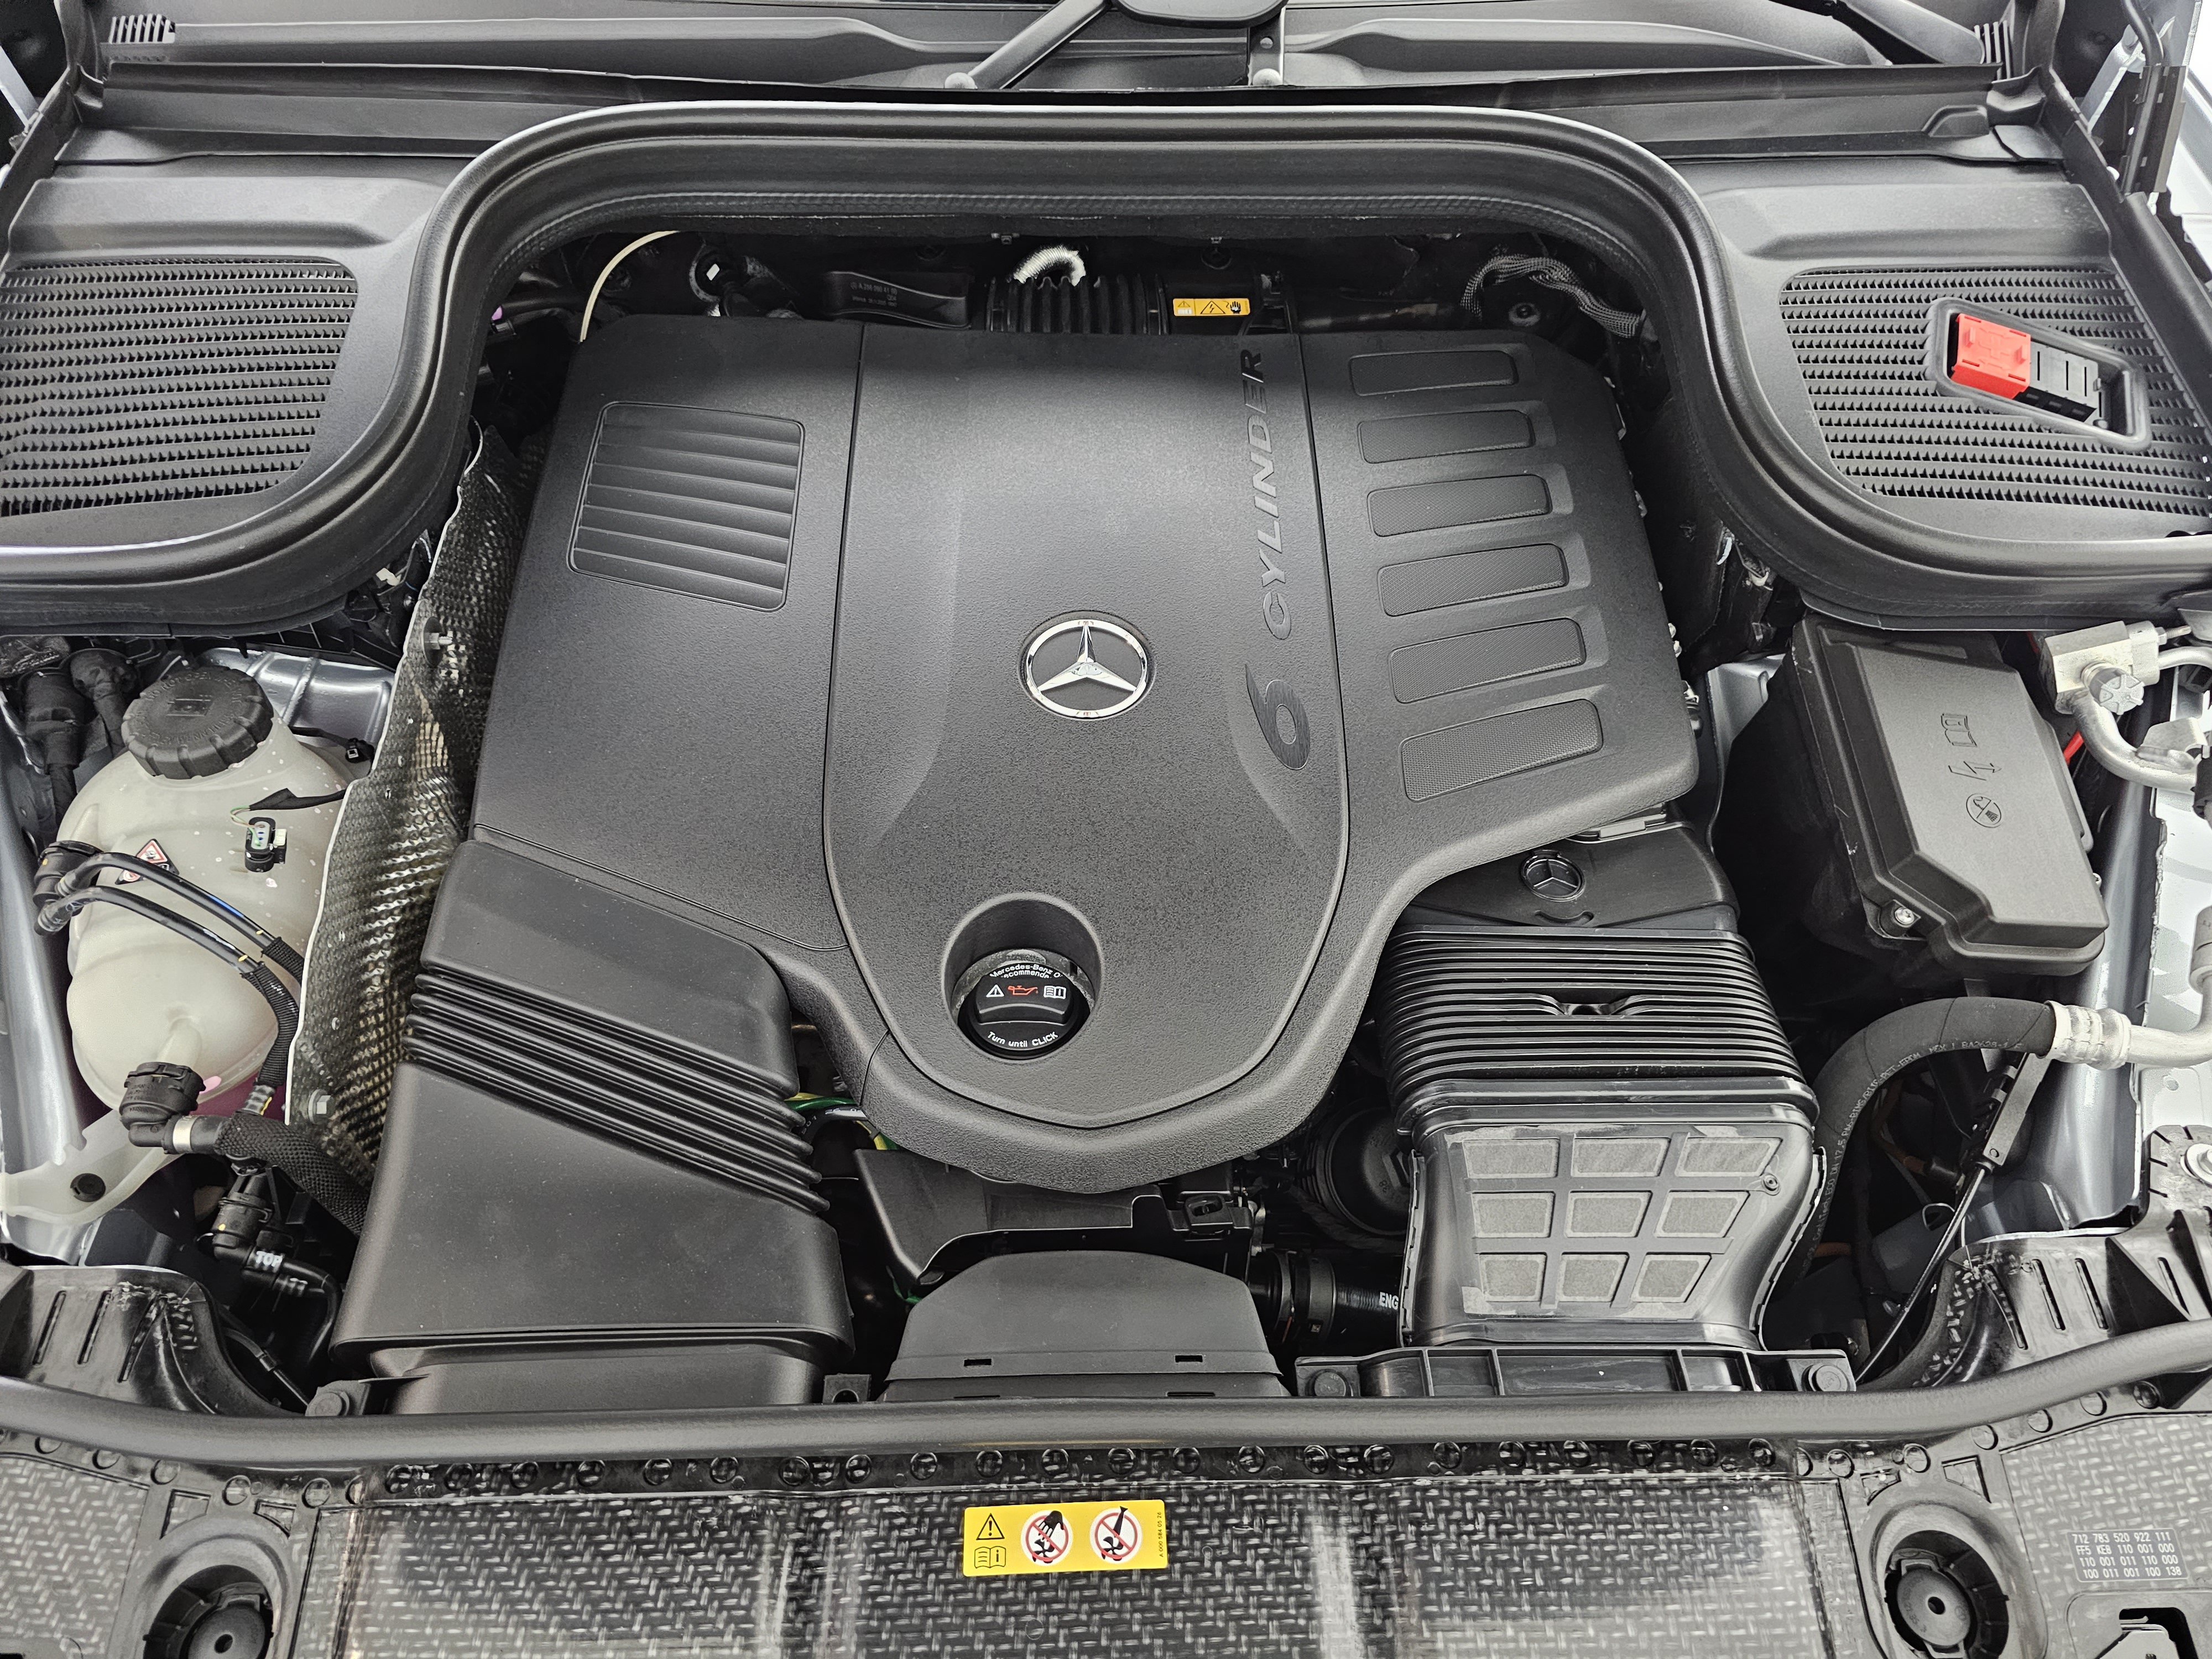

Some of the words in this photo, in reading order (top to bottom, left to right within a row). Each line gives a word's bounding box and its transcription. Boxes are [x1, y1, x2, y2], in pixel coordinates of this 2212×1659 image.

[1240, 349, 1292, 640] CYLINDER
[1245, 664, 1310, 770] 6
[989, 964, 1053, 978] Mercedes-Benz
[1000, 969, 1052, 979] ecommende
[987, 1031, 1006, 1045] Turn
[1031, 1031, 1058, 1046] CLICK
[256, 1250, 284, 1267] TOP
[1379, 1291, 1399, 1310] ENG
[2072, 1534, 2089, 1543] 712
[2093, 1533, 2109, 1543] 783
[2113, 1533, 2130, 1542] 520
[2134, 1532, 2151, 1542] 922
[2155, 1532, 2171, 1541] 111
[2076, 1547, 2091, 1555] FF5
[2117, 1545, 2133, 1554] 110
[2137, 1544, 2153, 1553] 001
[2158, 1544, 2174, 1552] 000
[2079, 1558, 2096, 1567] 110
[2100, 1557, 2116, 1566] 001
[2120, 1557, 2136, 1566] 011
[2142, 1556, 2158, 1565] 110
[2162, 1555, 2178, 1564] 000
[2083, 1569, 2099, 1579] 100
[2103, 1569, 2119, 1578] 011
[2124, 1568, 2140, 1577] 001
[2145, 1567, 2161, 1577] 100
[2166, 1567, 2182, 1575] 138
